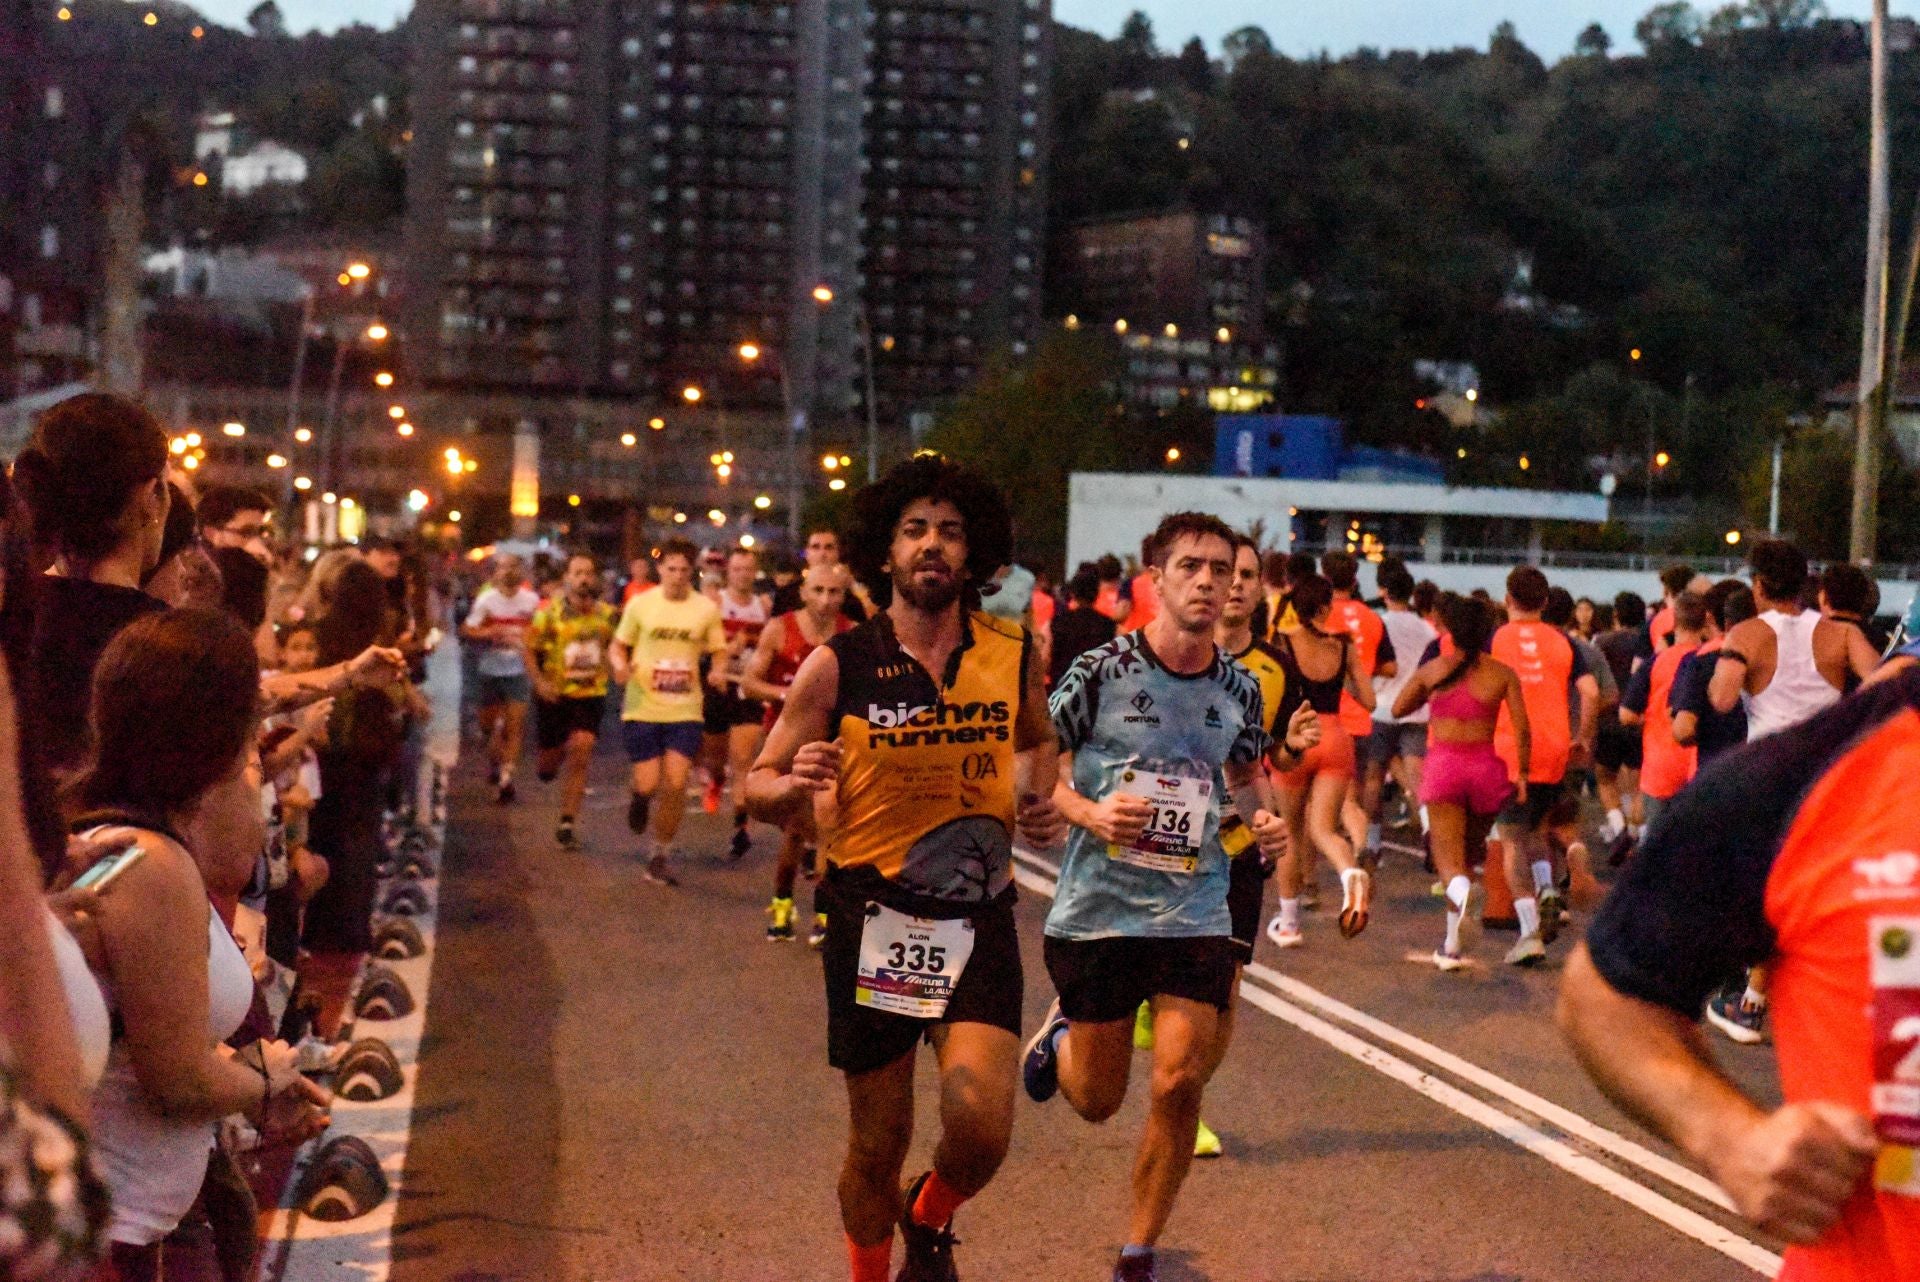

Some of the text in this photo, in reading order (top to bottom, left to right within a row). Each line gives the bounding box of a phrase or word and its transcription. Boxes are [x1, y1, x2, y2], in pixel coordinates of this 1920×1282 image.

[868, 700, 1010, 729] bichos
[1123, 715, 1160, 724] FORTUNA
[868, 725, 1010, 749] runners
[1150, 807, 1191, 834] 136
[1185, 859, 1193, 870] 2
[908, 933, 930, 941] ALON
[887, 941, 946, 974] 335
